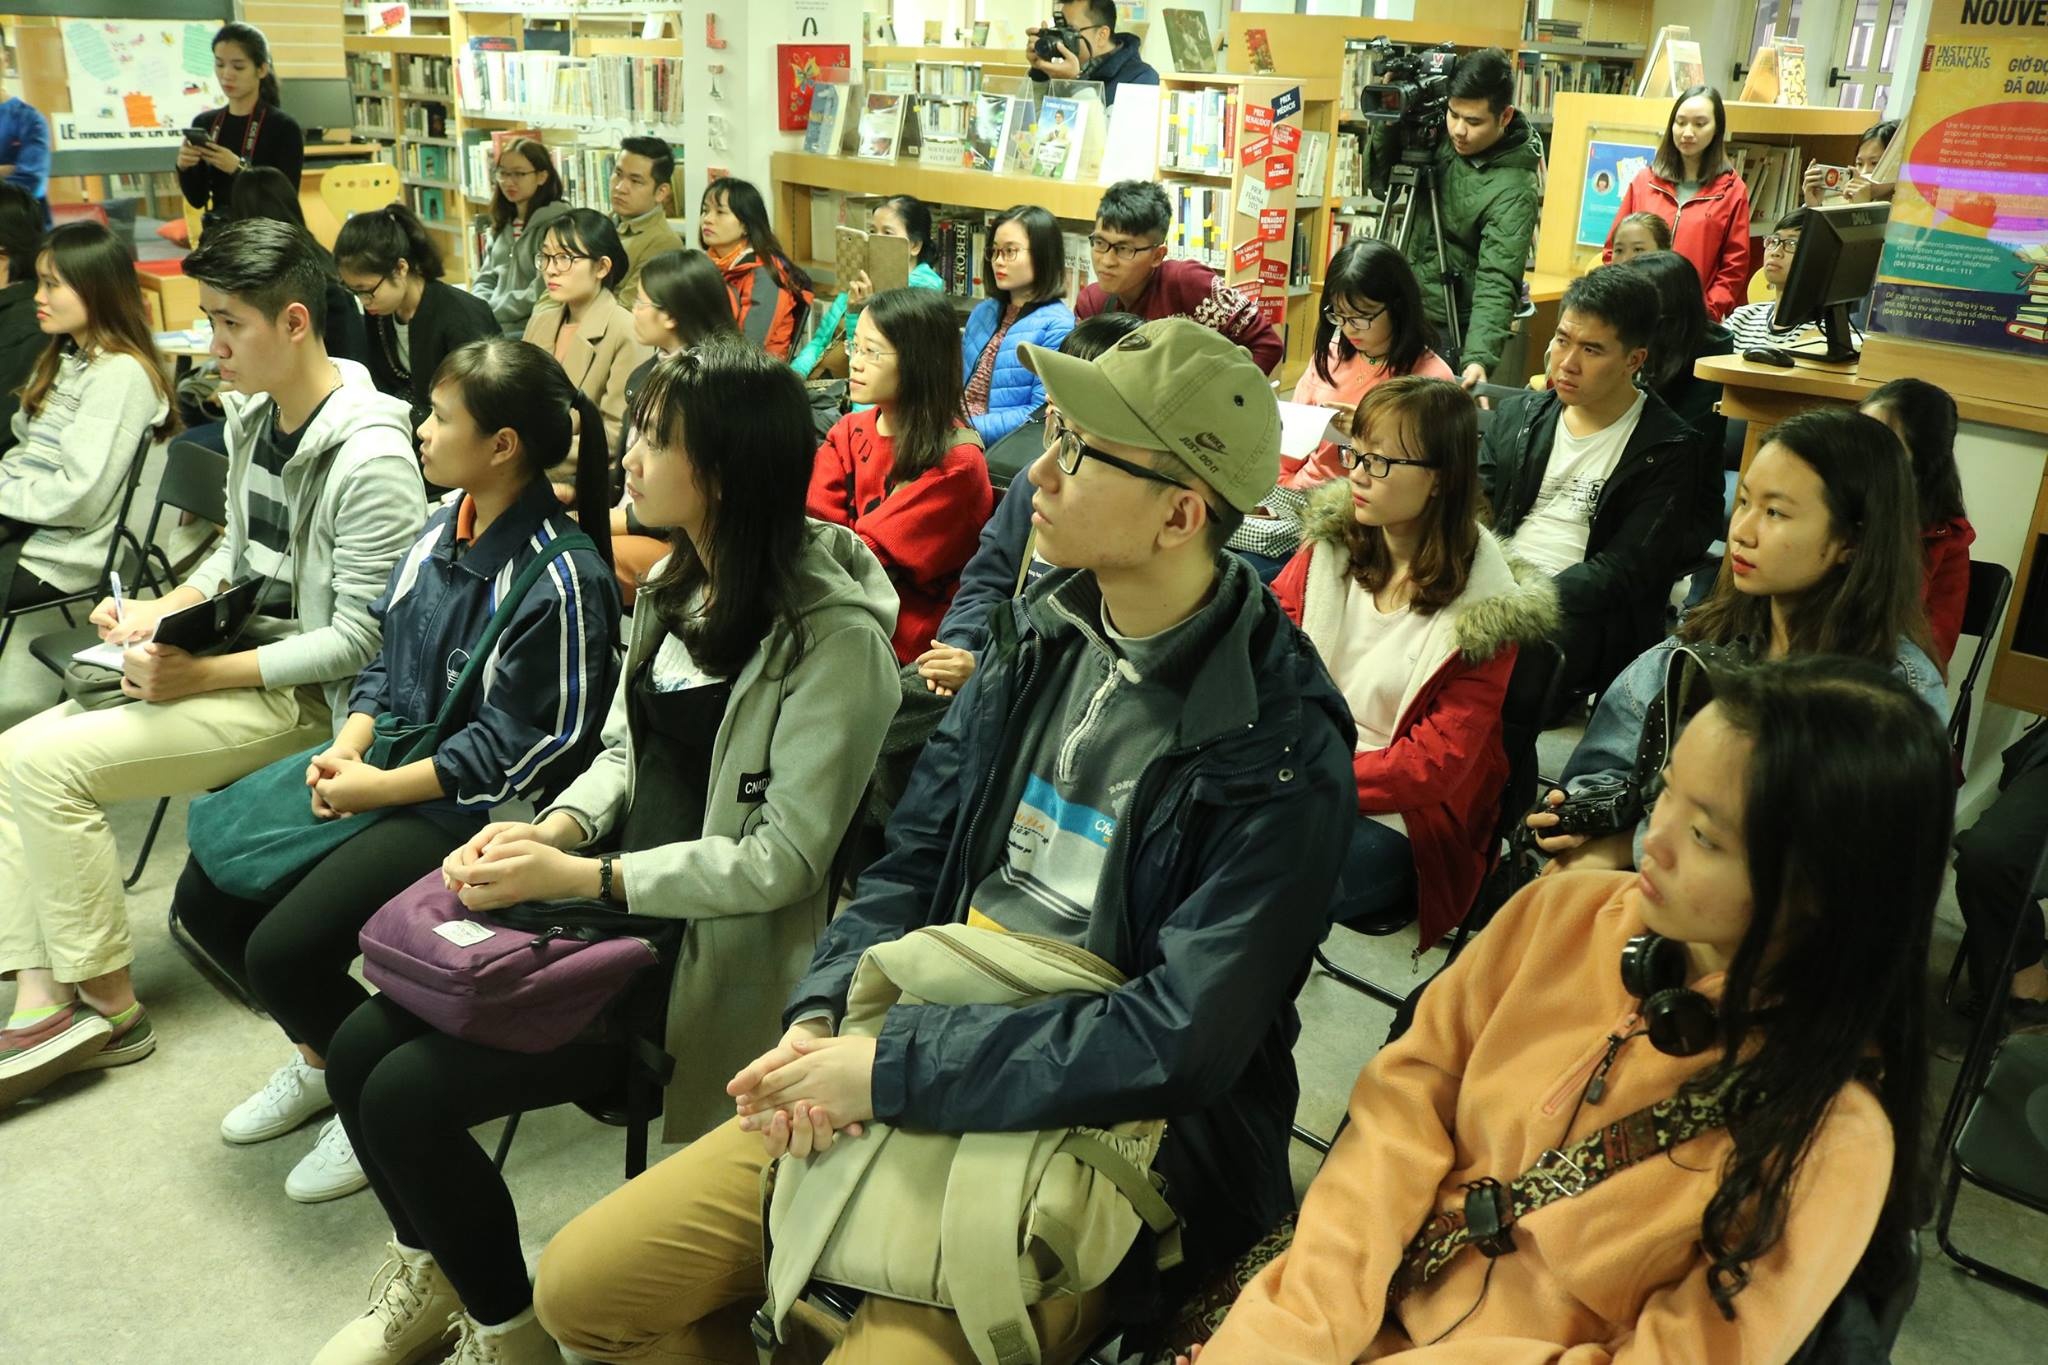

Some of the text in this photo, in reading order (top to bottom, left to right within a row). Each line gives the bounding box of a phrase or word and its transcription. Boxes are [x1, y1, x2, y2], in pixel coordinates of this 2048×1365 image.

[1961, 0, 2048, 26] NOUVE
[1938, 45, 1988, 58] INSTITUT
[2008, 55, 2033, 73] GIỜ
[2003, 76, 2022, 94] ĐÃ
[1280, 93, 1292, 105] PRIX
[1253, 108, 1265, 117] PRIX
[60, 124, 75, 140] LE
[1206, 432, 1226, 449] NIKE
[1179, 437, 1219, 474] JUST DO IT
